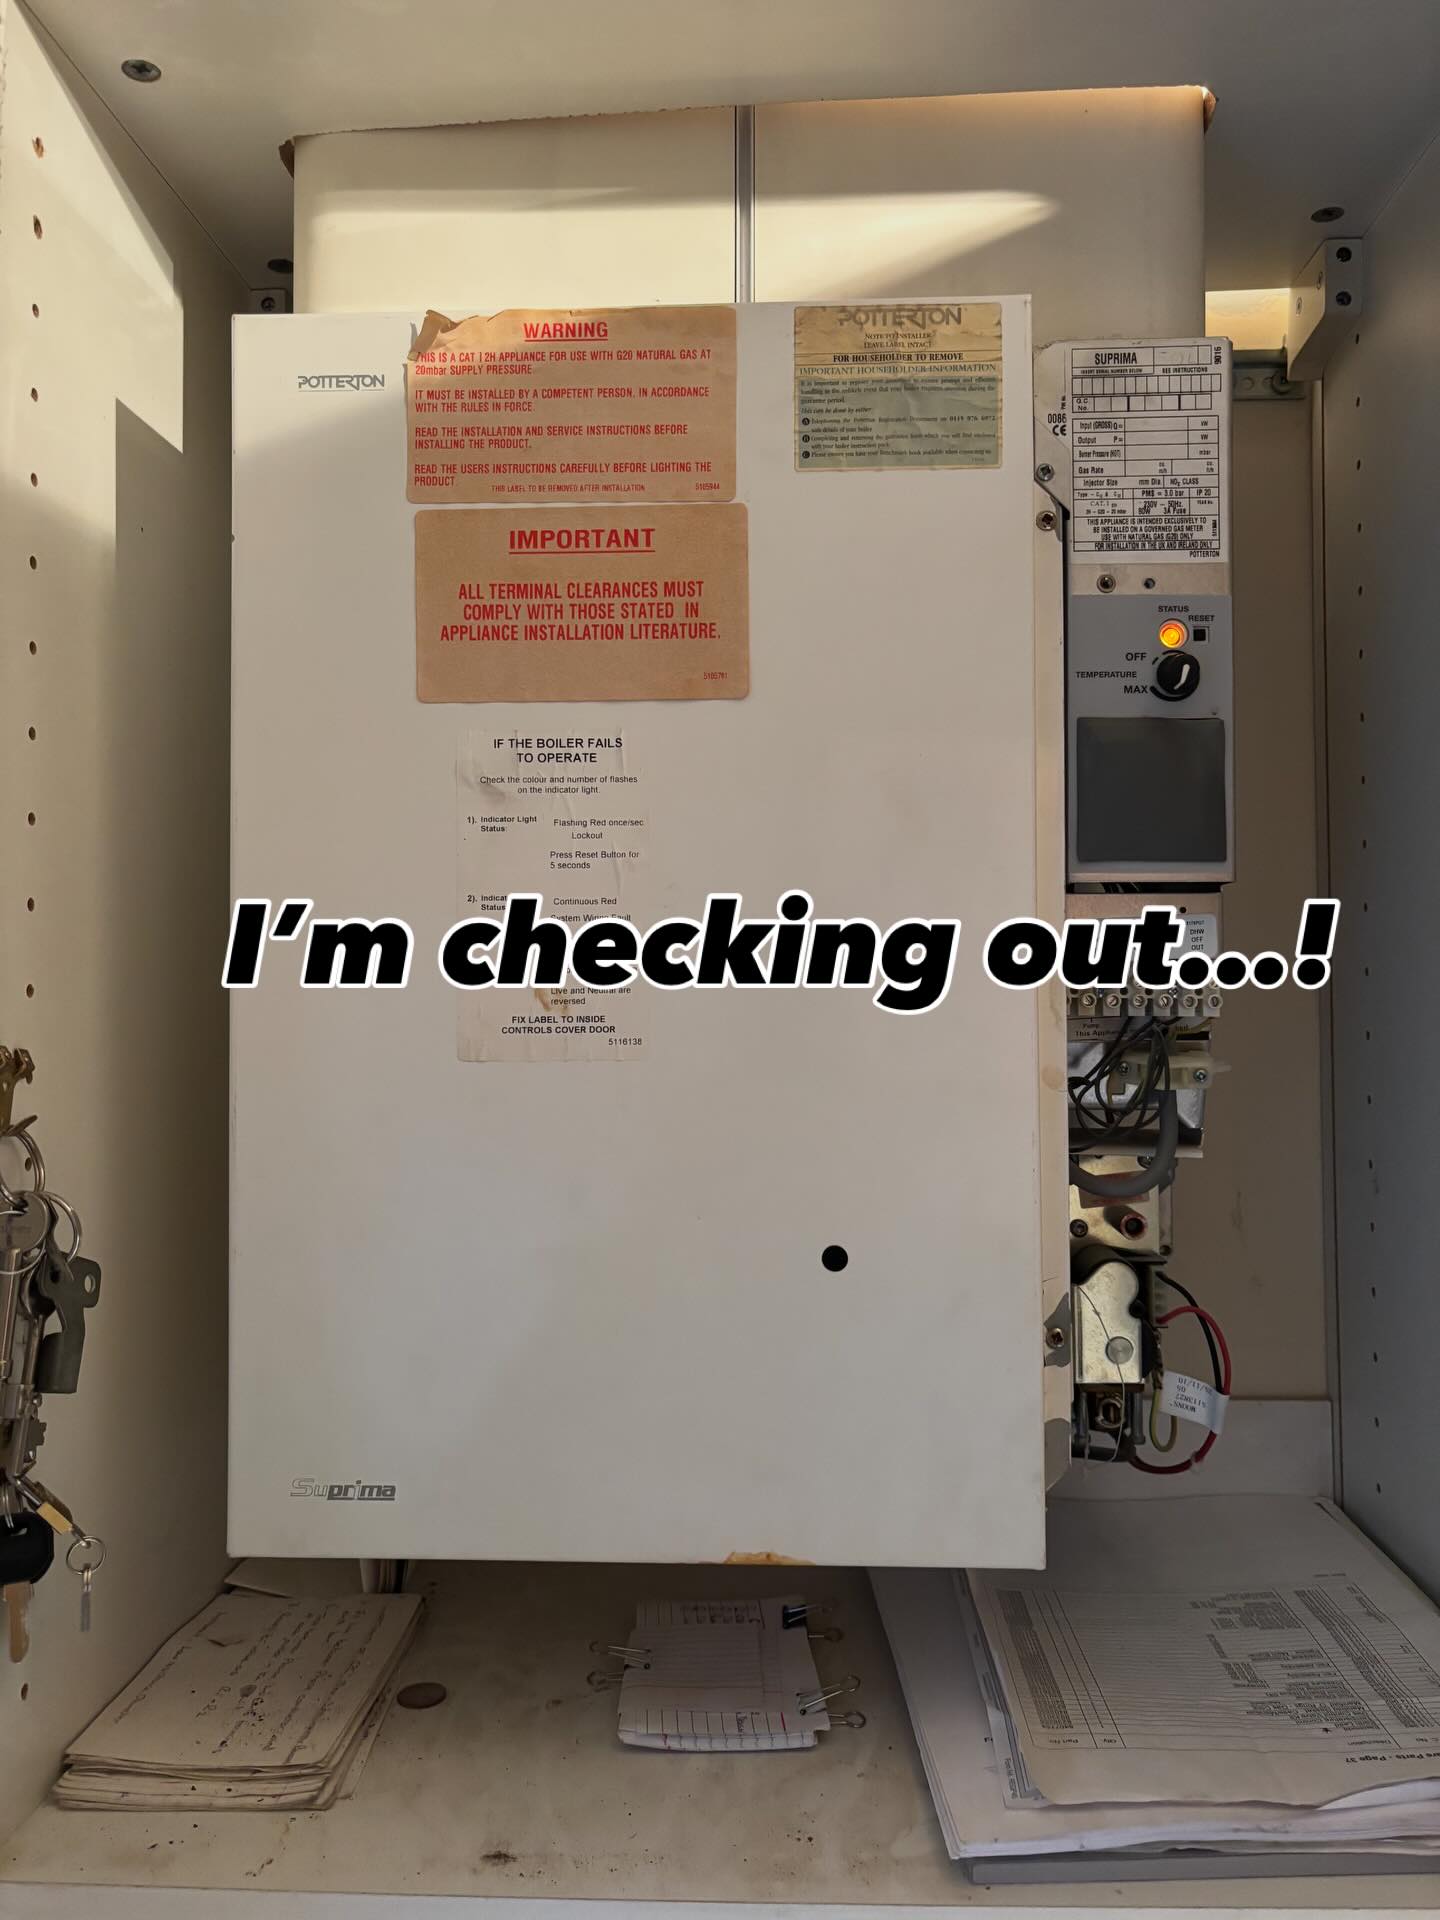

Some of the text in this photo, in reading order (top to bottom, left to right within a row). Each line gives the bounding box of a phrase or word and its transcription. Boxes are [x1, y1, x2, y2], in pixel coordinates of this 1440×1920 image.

[838, 307, 962, 329] POTTERTON
[524, 322, 608, 339] WARNING
[439, 349, 712, 363] IS A CAT 2H APPLIANCE FOR USE WITH G20 NATURAL GAS AT
[852, 354, 912, 362] HOUSEHOLDER
[1094, 352, 1138, 365] SUPRIMA
[415, 364, 533, 376] 20mbar SUPPLY PRESSURE
[800, 364, 996, 375] IMPORTANT HOUSEHOLDER INFORMATION
[298, 374, 384, 391] POTTERTON
[415, 387, 710, 400] IT MUST BE INSTALLED BY A COMPETENT IN ACCORDANCE
[415, 402, 437, 413] WITH
[442, 402, 457, 412] THE
[461, 402, 489, 412] RULES
[492, 402, 501, 412] IN
[1048, 414, 1067, 423] 0086
[415, 425, 688, 437] READ THE INSTALLATION AND SERVICE INSTRUCTIONS BEFORE
[415, 438, 532, 450] INSTALLING THE PRODUCT.
[415, 462, 712, 474] READ THE USERS INSTRUCTIONS CAREFULLY BEFORE LIGHTING THE
[414, 476, 455, 487] PRODUCT
[509, 528, 656, 549] IMPORTANT
[458, 581, 704, 600] ALL TERMINAL CLEARANCES MUST
[463, 602, 699, 620] COMPLY WITH THOSE STATED IN
[440, 623, 721, 641] APPLIANCE INSTALLATION LITERATURE.
[1125, 653, 1147, 661] OFF
[493, 738, 623, 748] IF THE BOILER FAILS
[517, 753, 597, 763] TO OPERATE
[290, 1478, 396, 1500] Suprima
